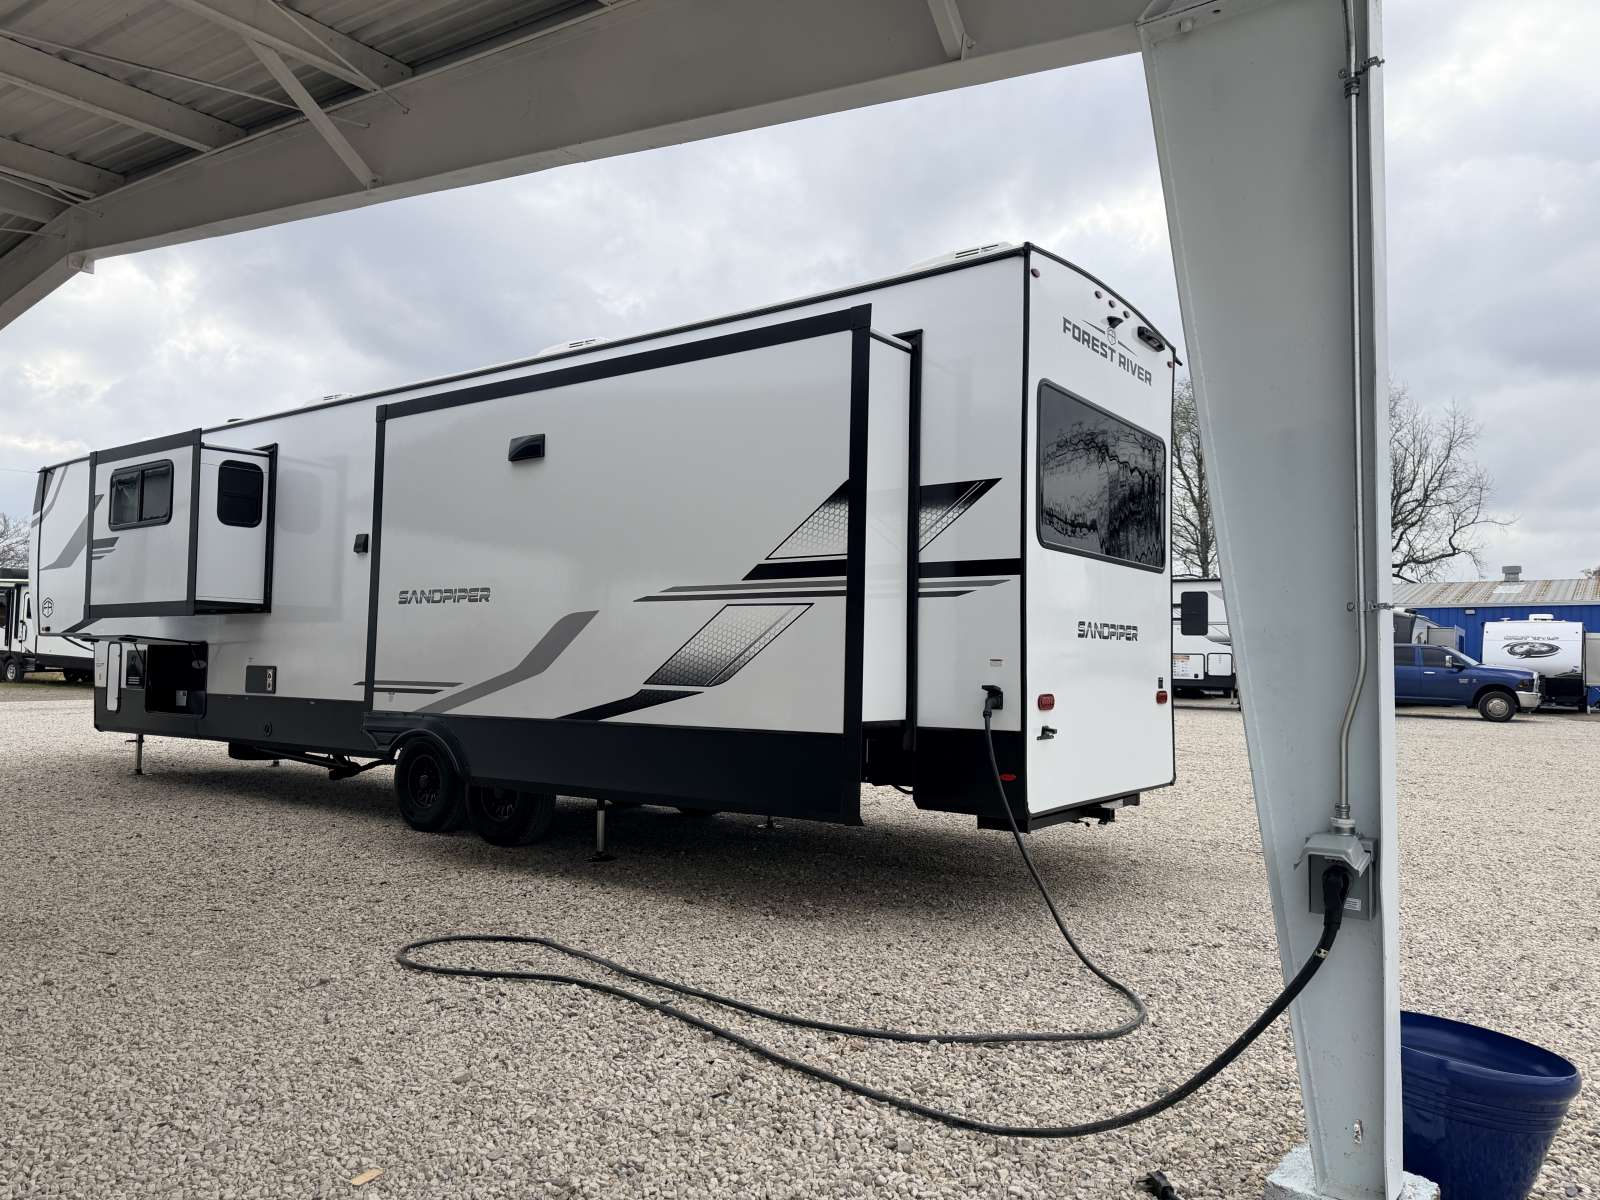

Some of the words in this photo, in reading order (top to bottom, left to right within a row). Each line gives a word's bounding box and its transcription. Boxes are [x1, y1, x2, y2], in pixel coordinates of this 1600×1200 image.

[1062, 316, 1117, 363] FOREST
[1118, 352, 1152, 386] RIVER
[398, 587, 491, 605] SANDPIPER
[1077, 620, 1138, 642] SANDPIPER
